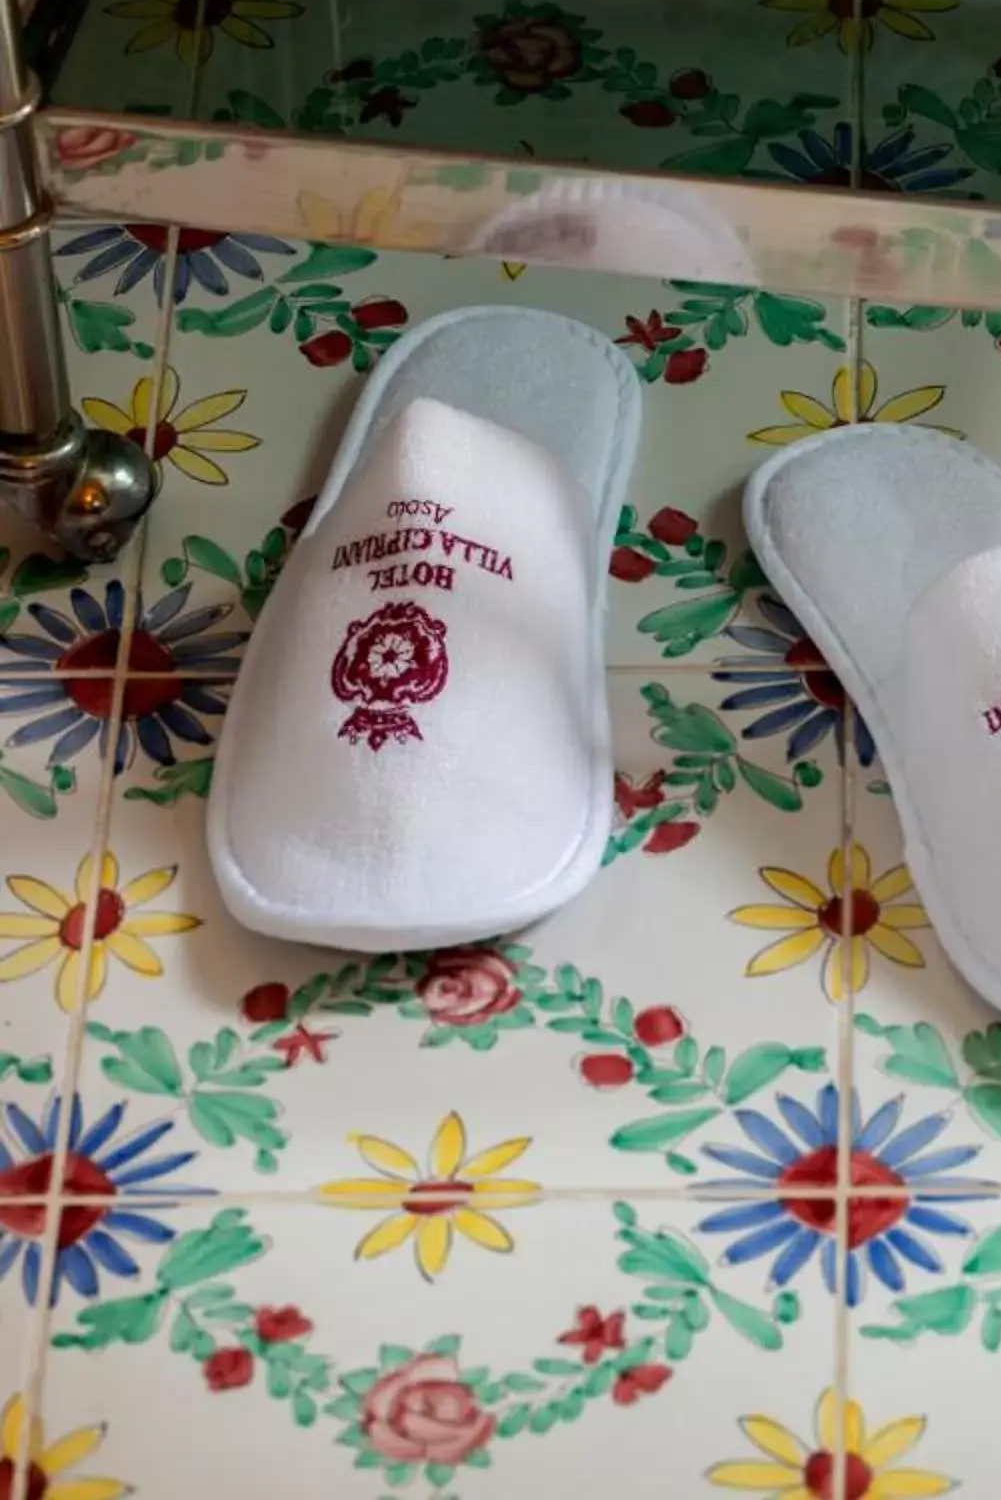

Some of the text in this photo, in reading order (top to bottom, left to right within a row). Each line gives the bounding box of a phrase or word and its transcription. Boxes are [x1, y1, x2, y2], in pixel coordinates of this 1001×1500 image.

[332, 526, 514, 581] VILLA CIPRIANI
[367, 560, 454, 591] HOTEL
